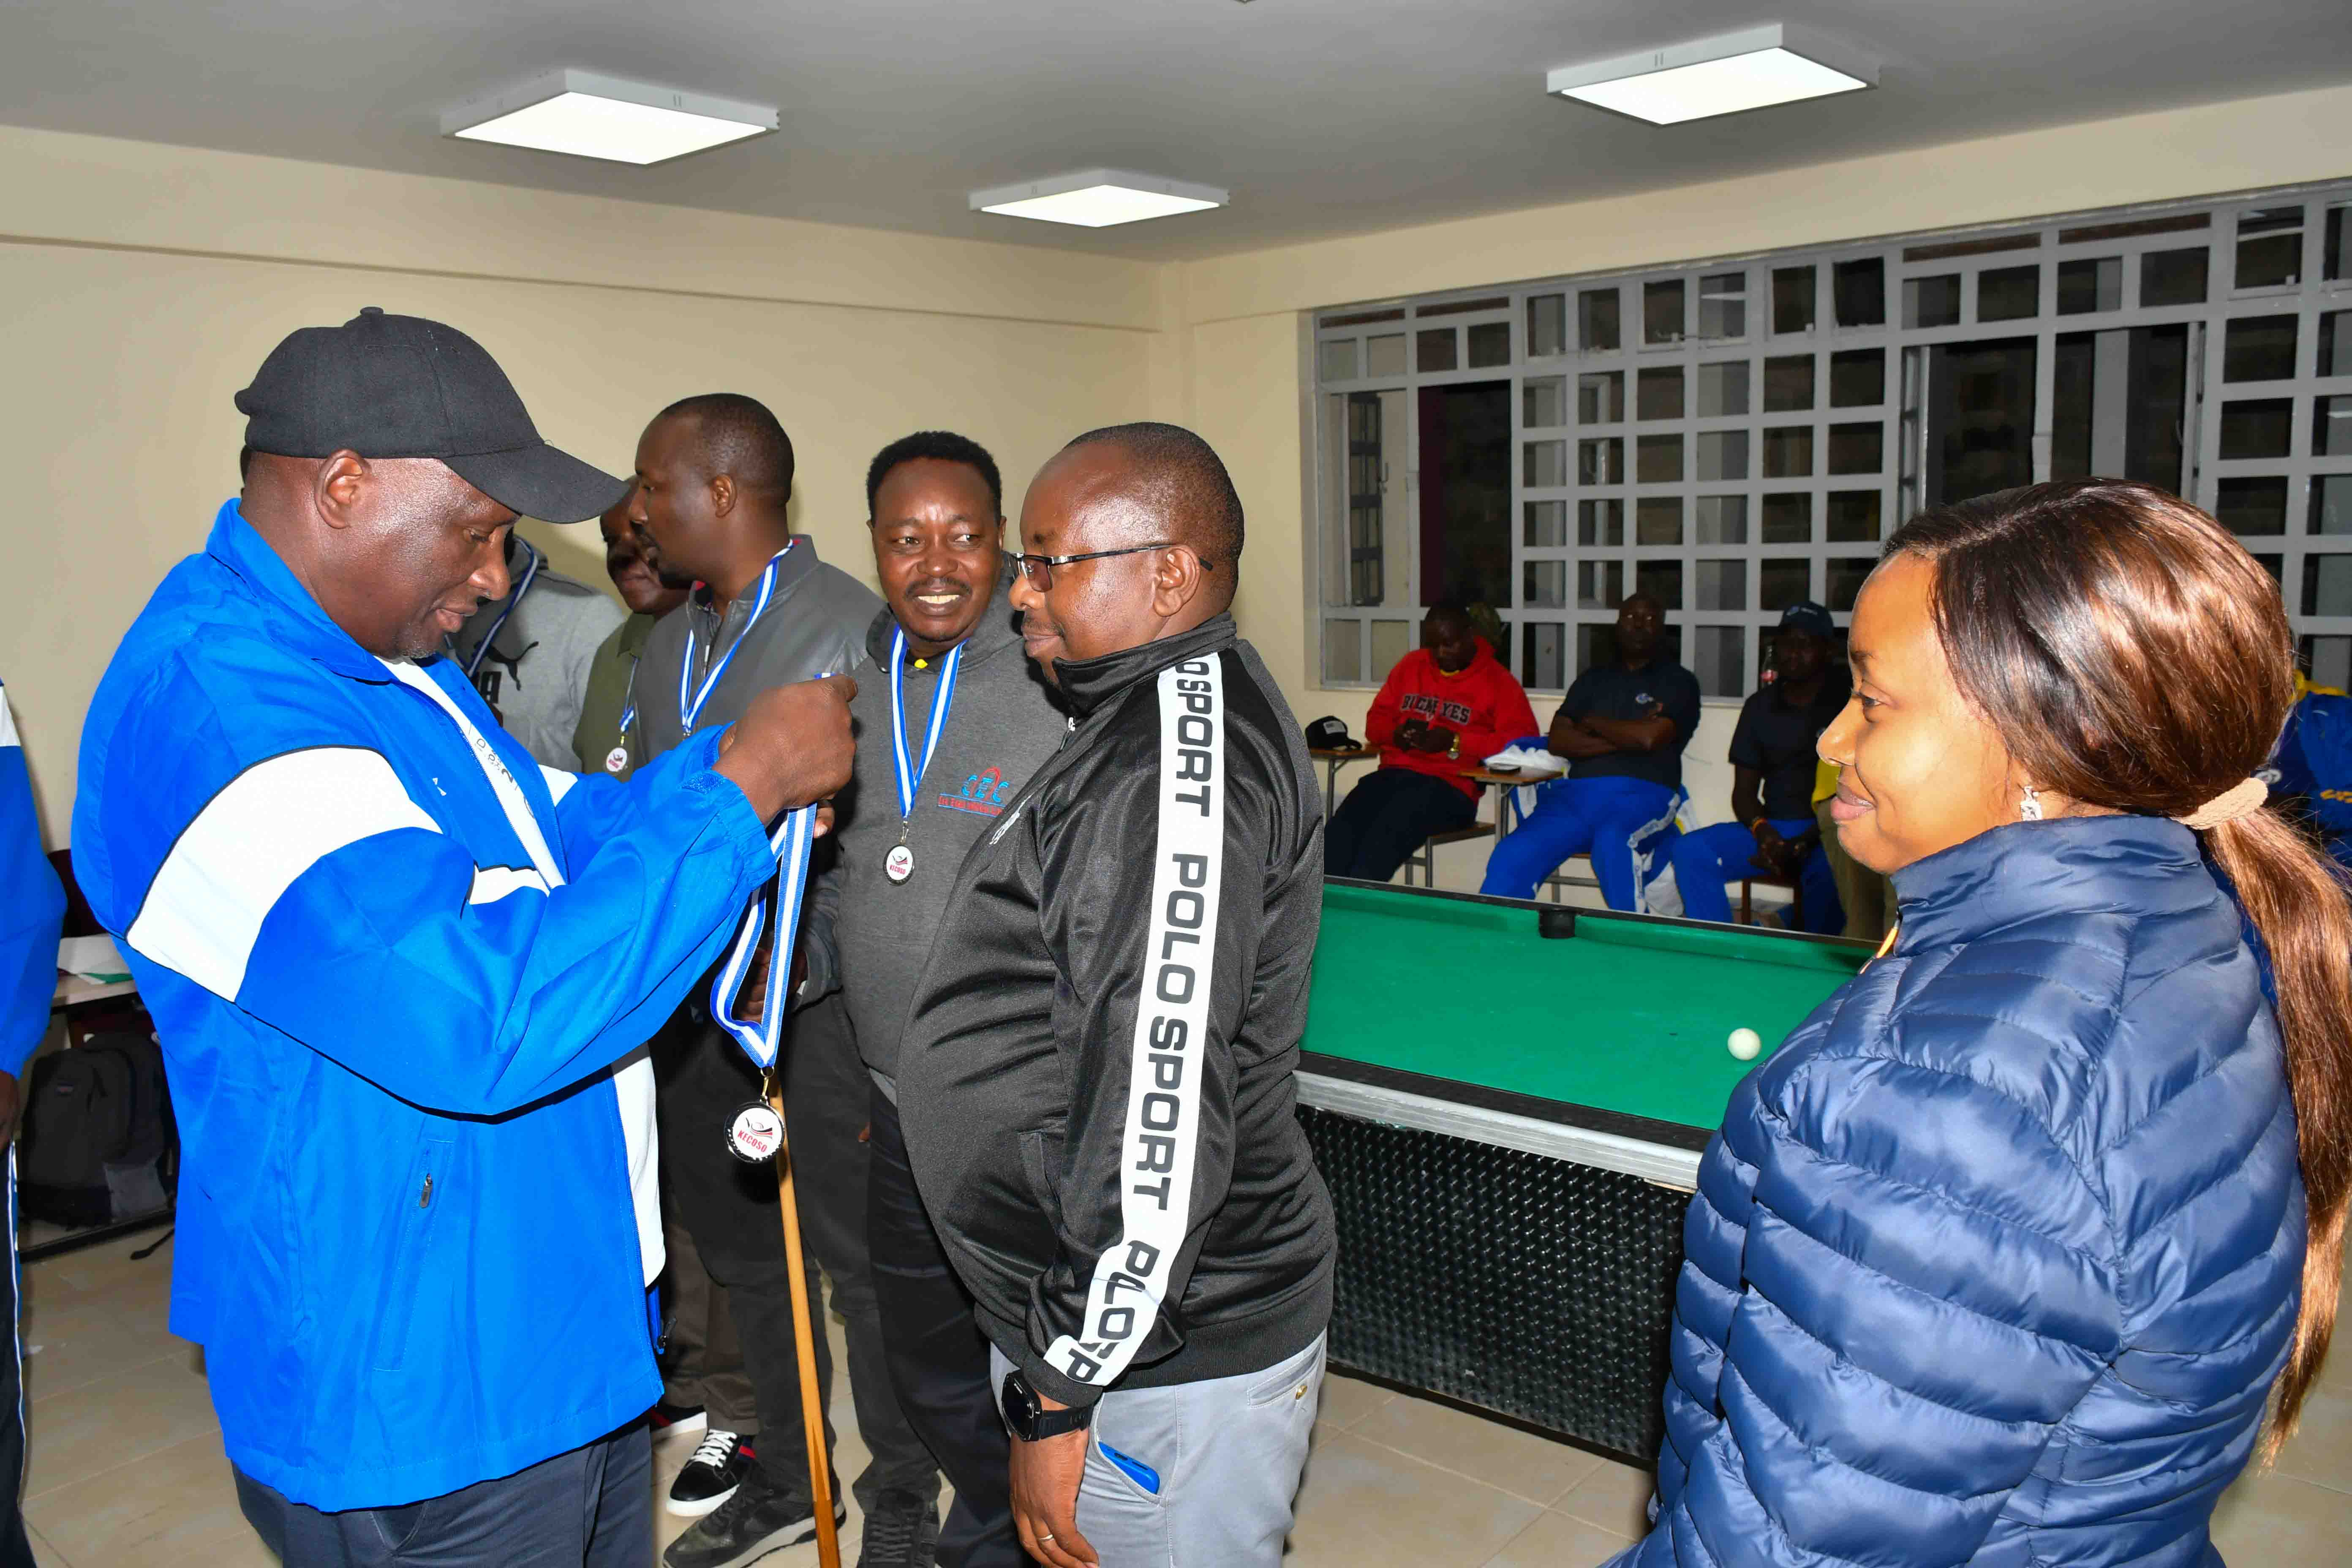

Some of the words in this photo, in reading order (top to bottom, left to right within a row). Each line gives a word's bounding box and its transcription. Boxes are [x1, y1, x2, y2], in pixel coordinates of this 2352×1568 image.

[1175, 678, 1213, 817] SPORT
[1156, 853, 1208, 1004] POLO
[737, 1130, 768, 1153] KECOSO
[1133, 1017, 1188, 1211] SPORT
